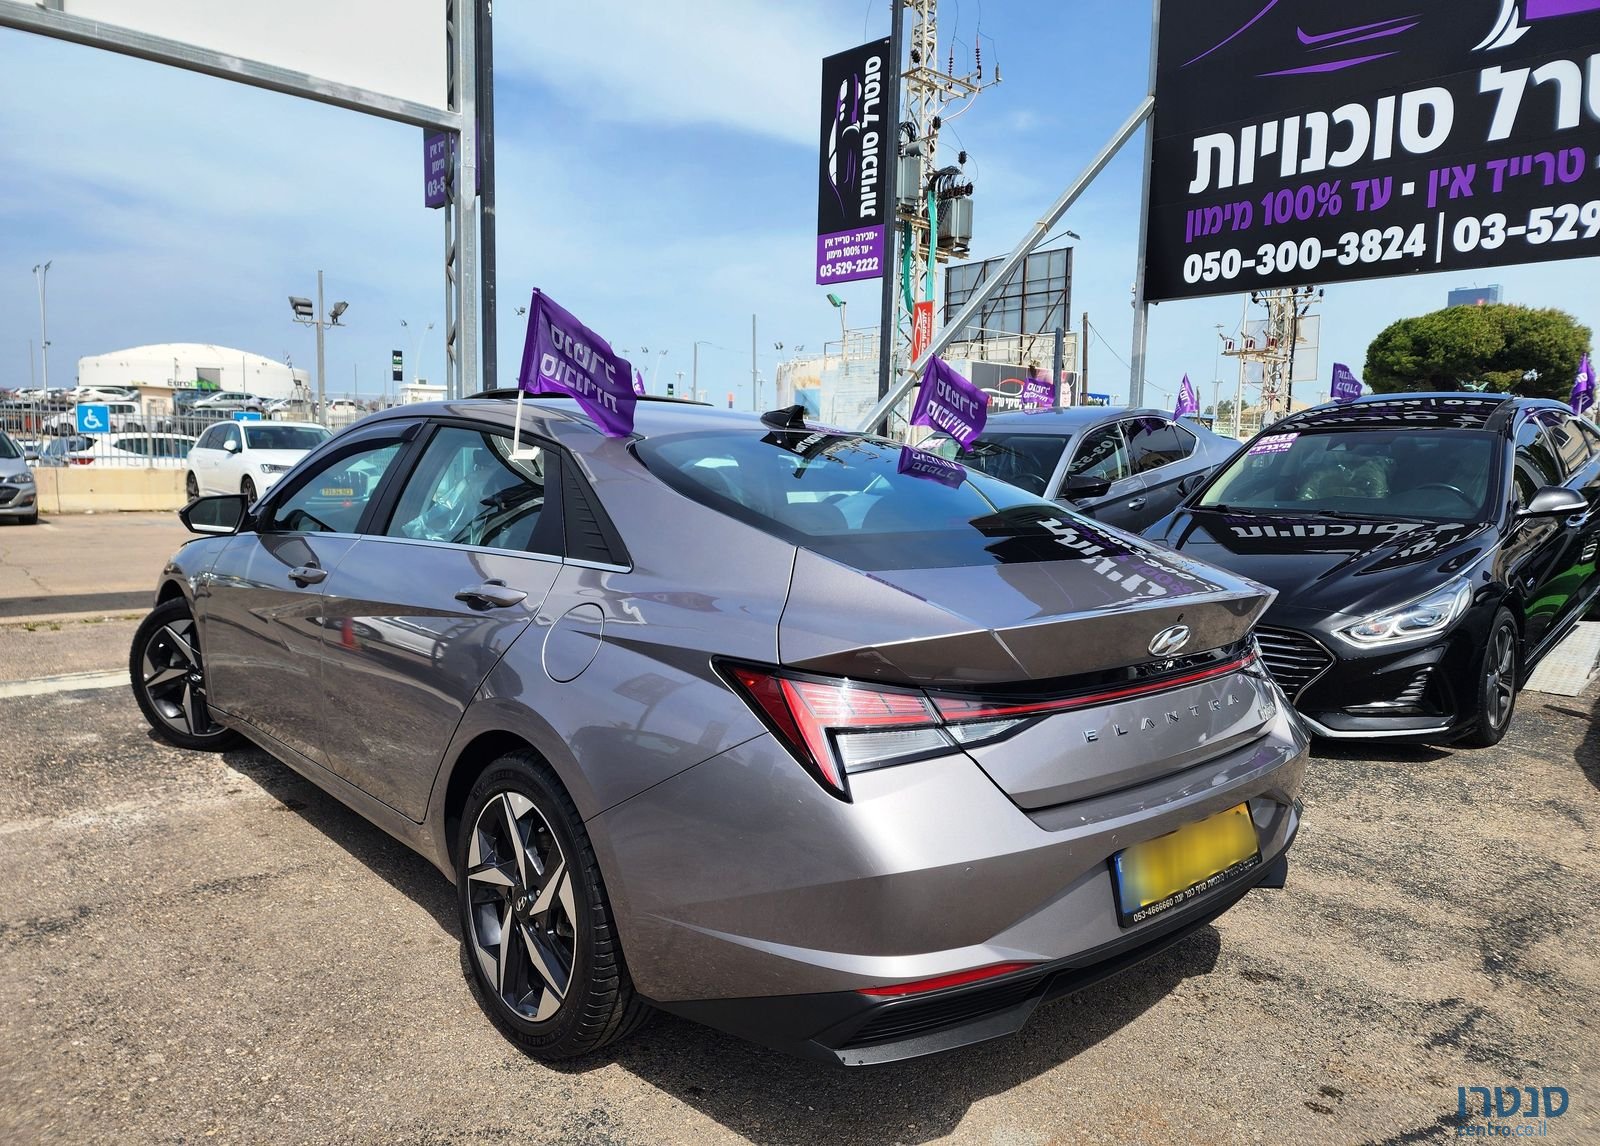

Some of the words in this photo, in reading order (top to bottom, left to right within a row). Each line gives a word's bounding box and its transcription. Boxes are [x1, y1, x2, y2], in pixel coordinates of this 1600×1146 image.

[862, 55, 882, 129] סנטרל
[1188, 86, 1455, 194] סוכנויות
[860, 131, 879, 218] סוכנויות
[1427, 163, 1476, 208] אין
[1485, 146, 1586, 190] טרייד
[1260, 179, 1343, 224] 100%
[1351, 176, 1394, 212] עד
[1184, 200, 1254, 243] מימון
[820, 256, 879, 278] 03-529-2222
[842, 245, 860, 257] 100%
[1183, 223, 1427, 284] 050-300-3824
[1258, 432, 1299, 444] 2019
[1082, 694, 1240, 744] ELANTRA
